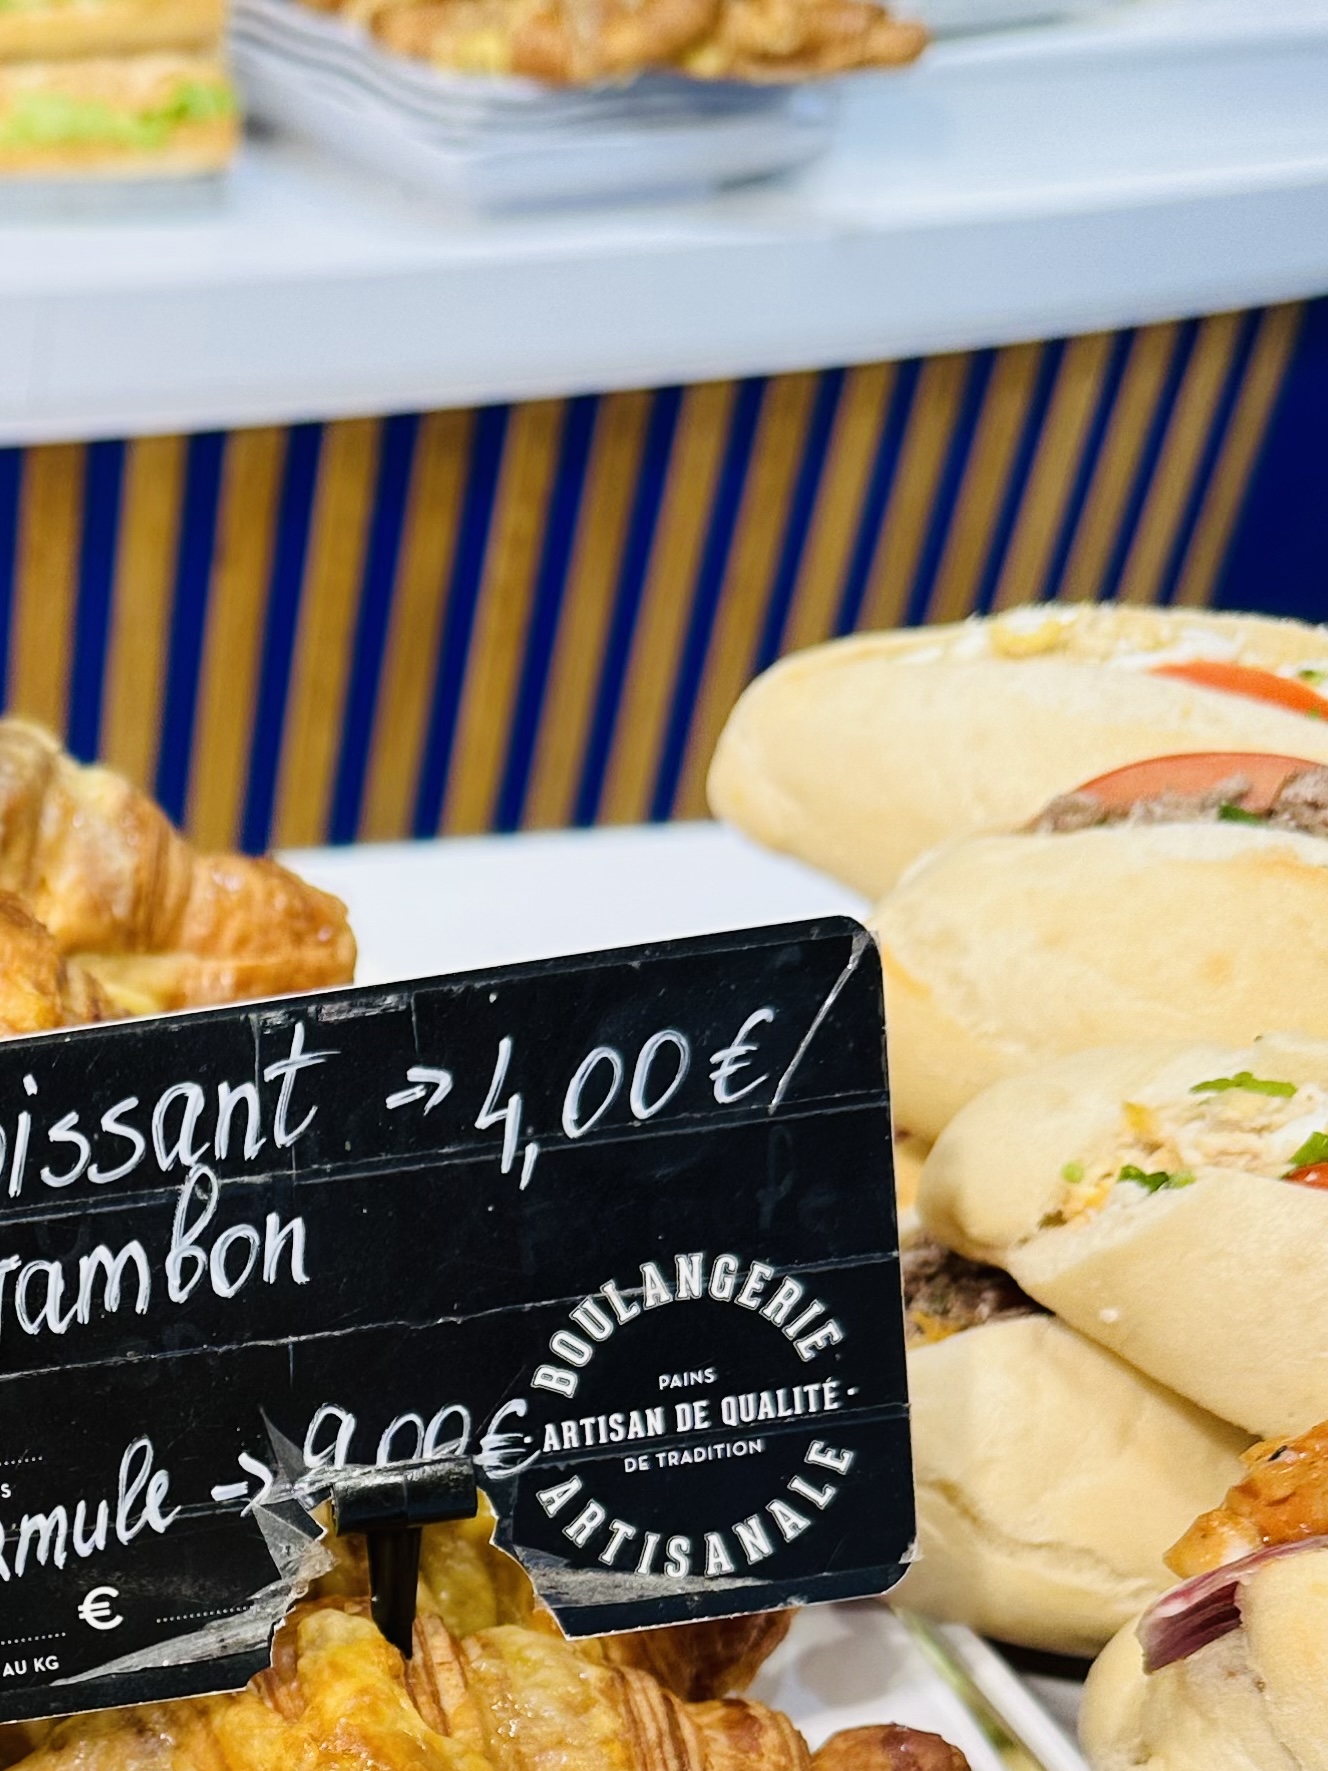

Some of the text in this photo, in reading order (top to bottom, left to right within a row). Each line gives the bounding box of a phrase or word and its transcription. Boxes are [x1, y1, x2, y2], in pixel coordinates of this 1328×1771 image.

[530, 1251, 842, 1399] BOULANGERIE
[658, 1368, 717, 1390] PAINS
[542, 1376, 842, 1452] ARTISAN DE QUALITÉ
[624, 1439, 764, 1473] DE TRADITION
[535, 1438, 854, 1579] ARTISANALE
[77, 1585, 123, 1630] €
[2, 1659, 28, 1677] AU
[33, 1655, 60, 1673] KG
